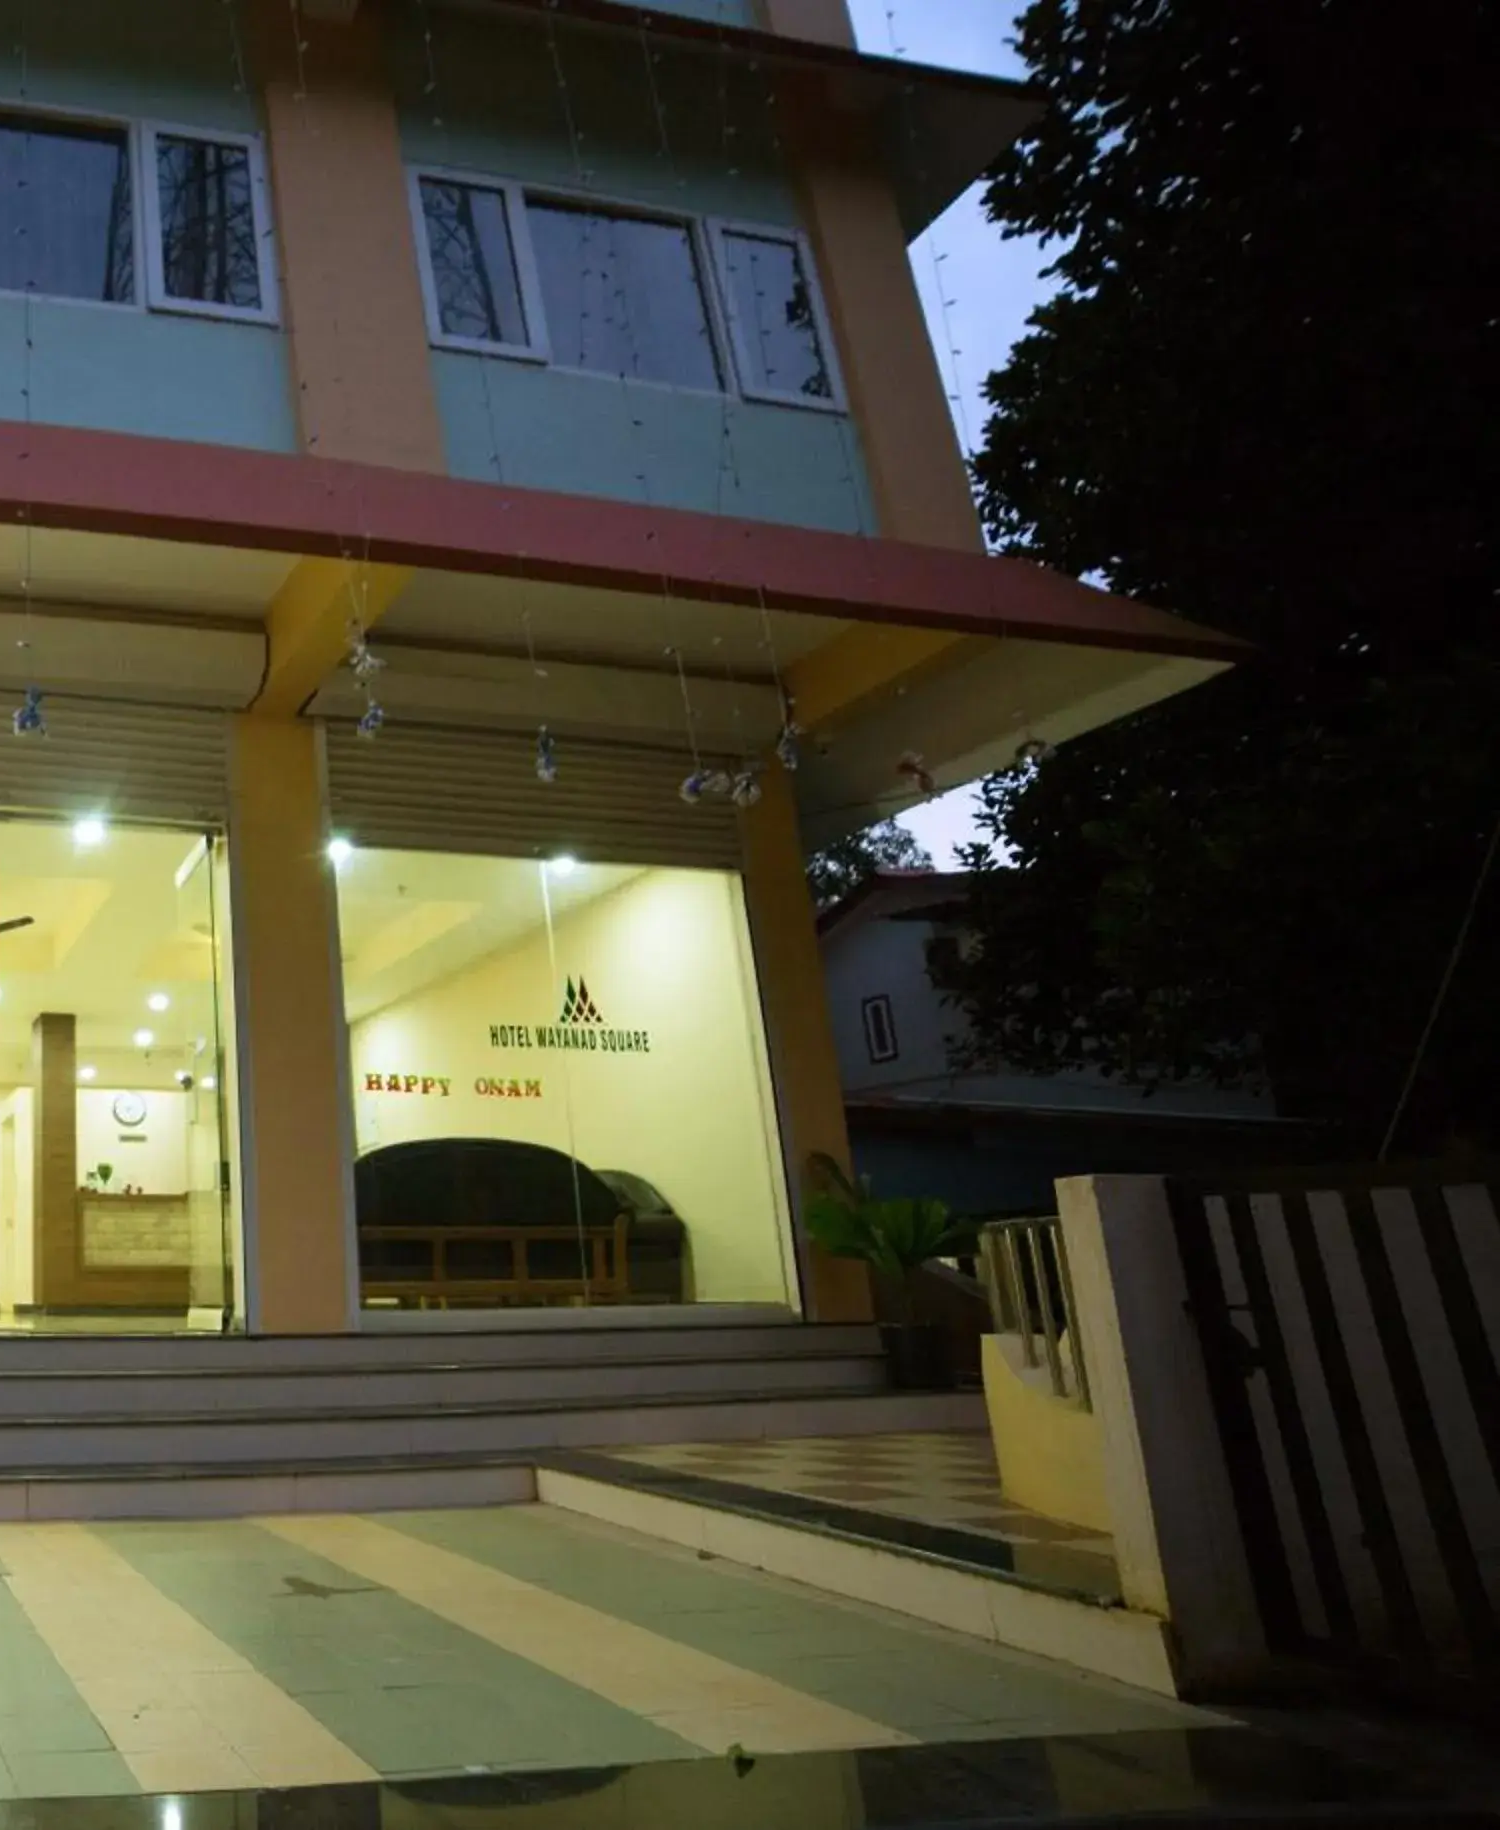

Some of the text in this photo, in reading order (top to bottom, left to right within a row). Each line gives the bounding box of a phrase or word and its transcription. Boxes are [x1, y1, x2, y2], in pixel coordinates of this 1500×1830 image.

[490, 1025, 650, 1053] HOTEL WAYANAD SQUARE
[365, 1074, 542, 1098] HAPPY ONAM
